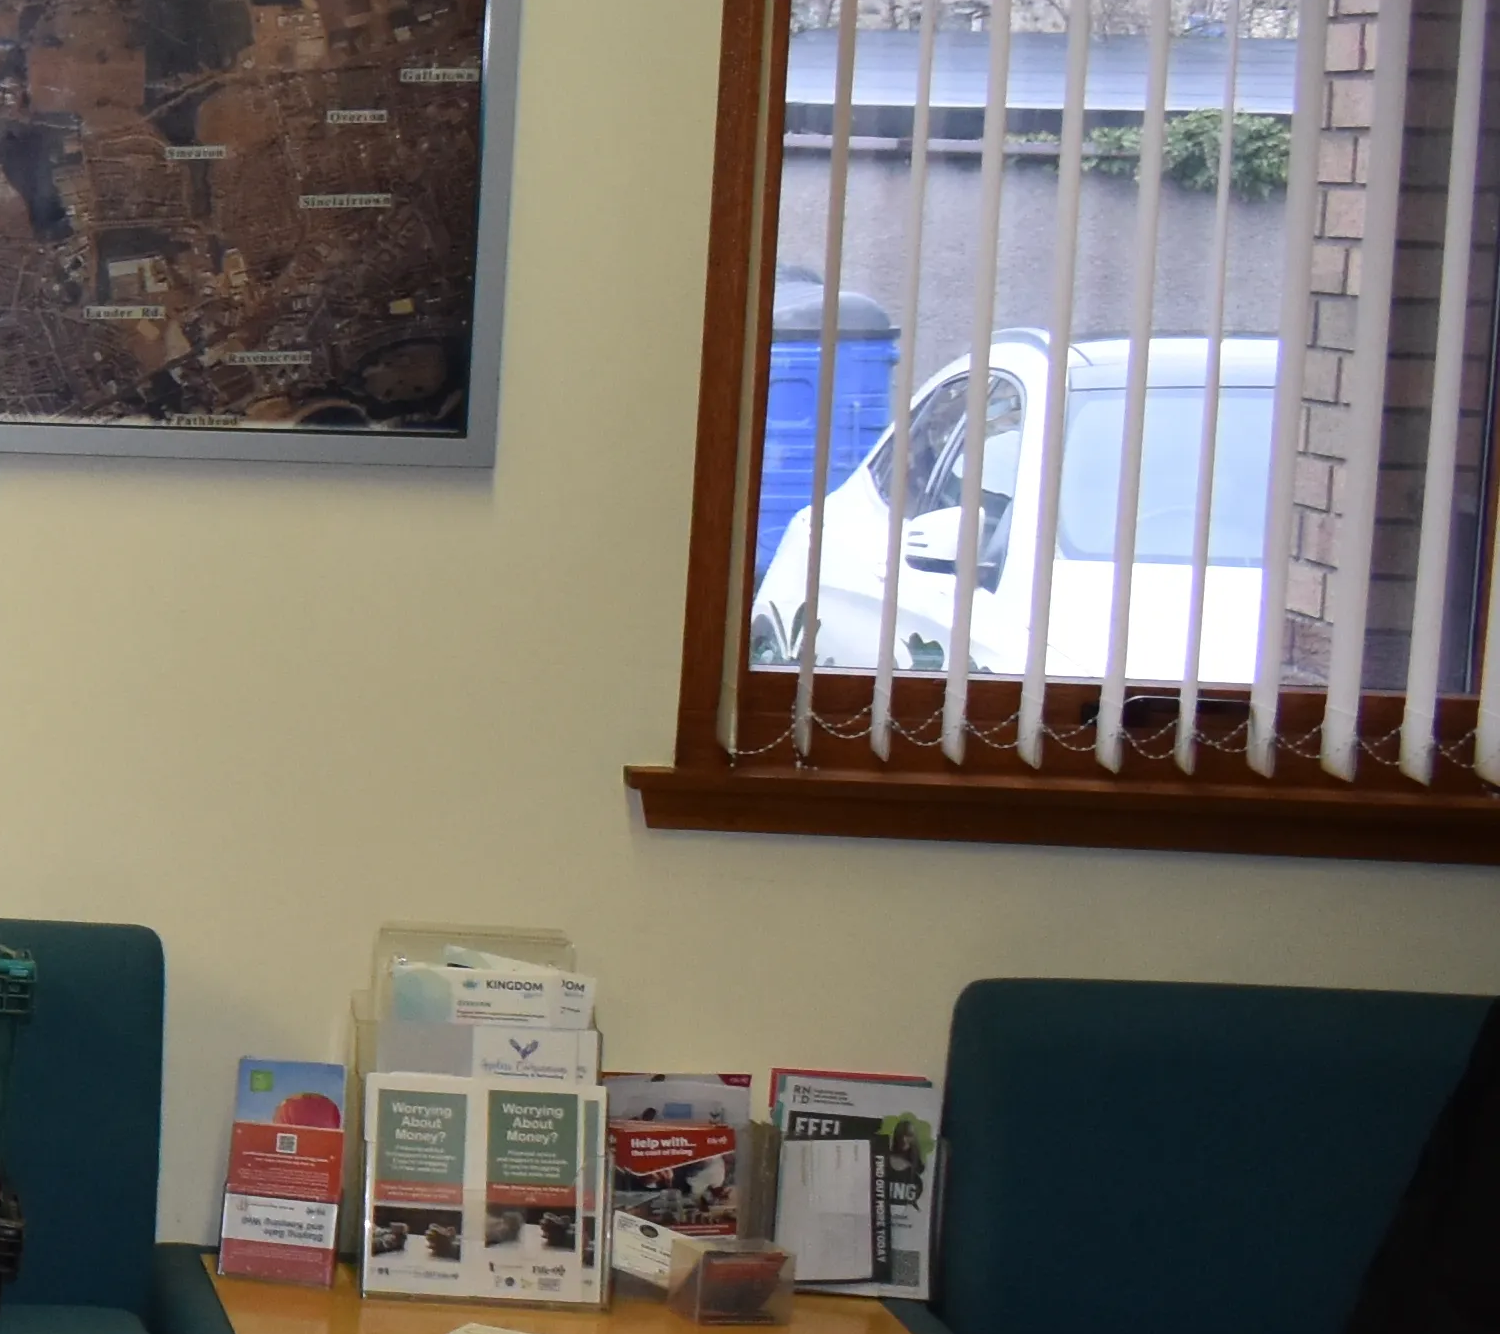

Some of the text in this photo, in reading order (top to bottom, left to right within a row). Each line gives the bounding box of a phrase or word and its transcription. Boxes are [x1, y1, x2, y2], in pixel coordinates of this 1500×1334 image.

[485, 979, 544, 993] KINGDOM
[391, 1101, 452, 1118] Worrying
[502, 1102, 565, 1119] Worrying
[401, 1116, 442, 1130] About
[512, 1117, 554, 1131] About
[395, 1129, 447, 1144] Money?
[506, 1130, 559, 1145] Money?
[630, 1138, 660, 1149] Help
[875, 1179, 886, 1198] OUT
[889, 1182, 917, 1201] ING
